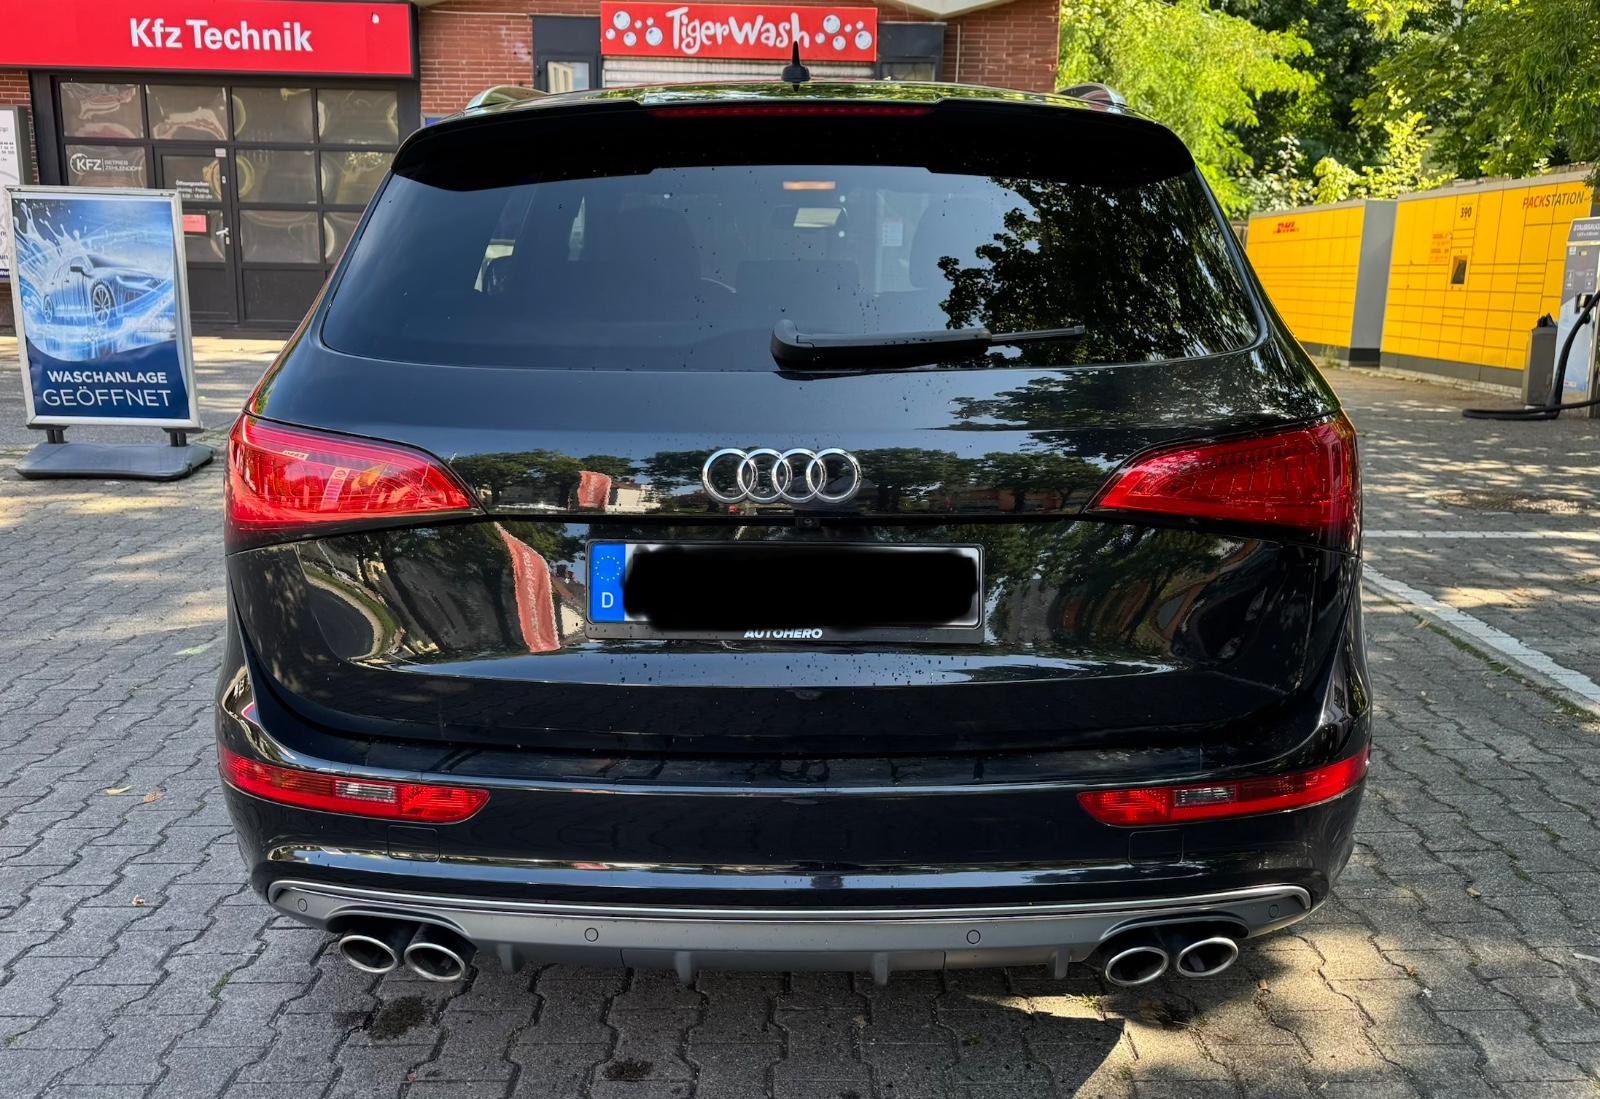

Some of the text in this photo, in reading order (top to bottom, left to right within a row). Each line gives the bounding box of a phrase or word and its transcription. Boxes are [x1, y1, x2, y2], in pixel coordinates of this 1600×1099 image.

[130, 17, 314, 52] Kfz Technik
[665, 7, 810, 54] TigerWash
[76, 158, 102, 171] KFZ
[1522, 191, 1585, 209] PACKSTATION
[1460, 206, 1473, 218] 390
[1273, 221, 1299, 234] DHL
[47, 370, 168, 384] WASCHANLAGE
[43, 386, 171, 407] GEÖFFNET
[601, 592, 614, 608] D
[743, 628, 823, 639] AUTOHERO
